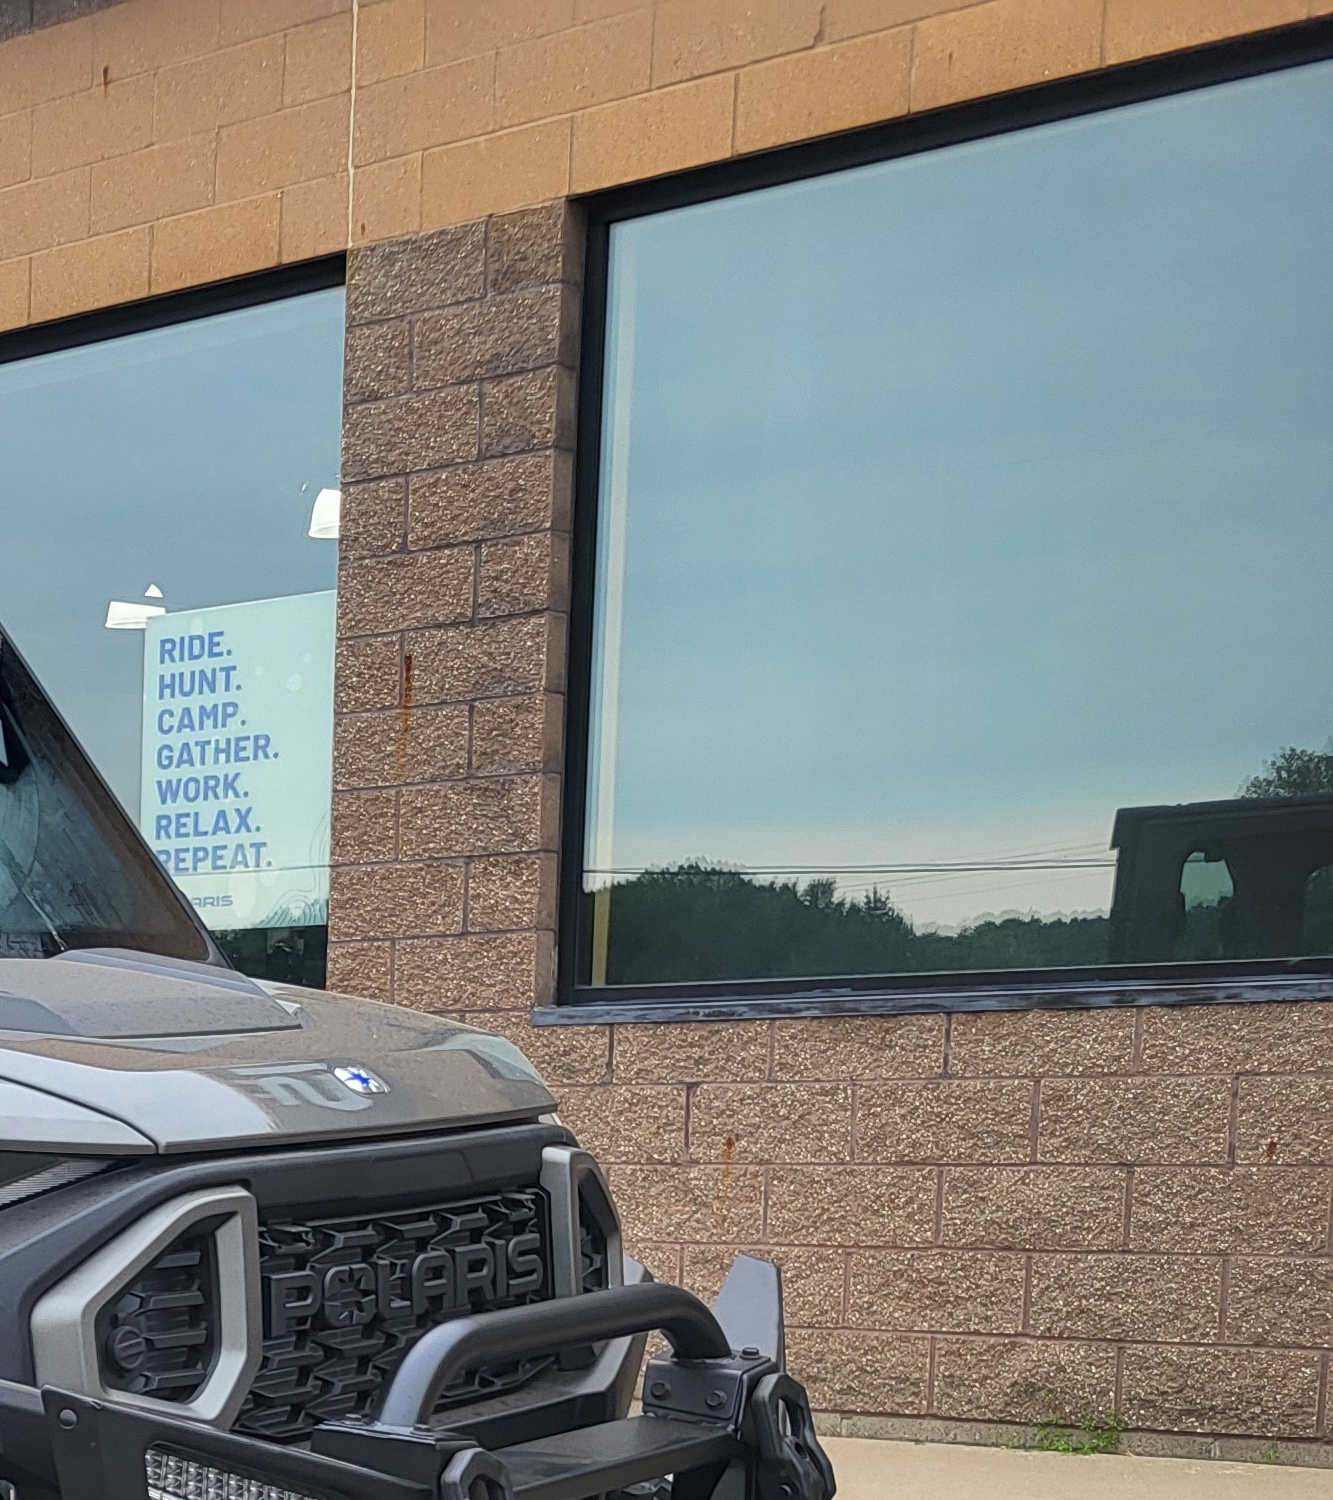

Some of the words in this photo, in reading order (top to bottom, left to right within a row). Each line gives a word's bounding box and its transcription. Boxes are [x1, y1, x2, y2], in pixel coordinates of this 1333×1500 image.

[159, 631, 232, 664] RIDE.
[158, 665, 242, 700] HUNT.
[157, 702, 246, 735] CAMP.
[156, 734, 279, 770] GATHER.
[156, 772, 249, 805] WORK.
[155, 807, 261, 841] RELAX.
[155, 842, 272, 874] REPEAT.
[269, 1232, 544, 1338] POLARIS
